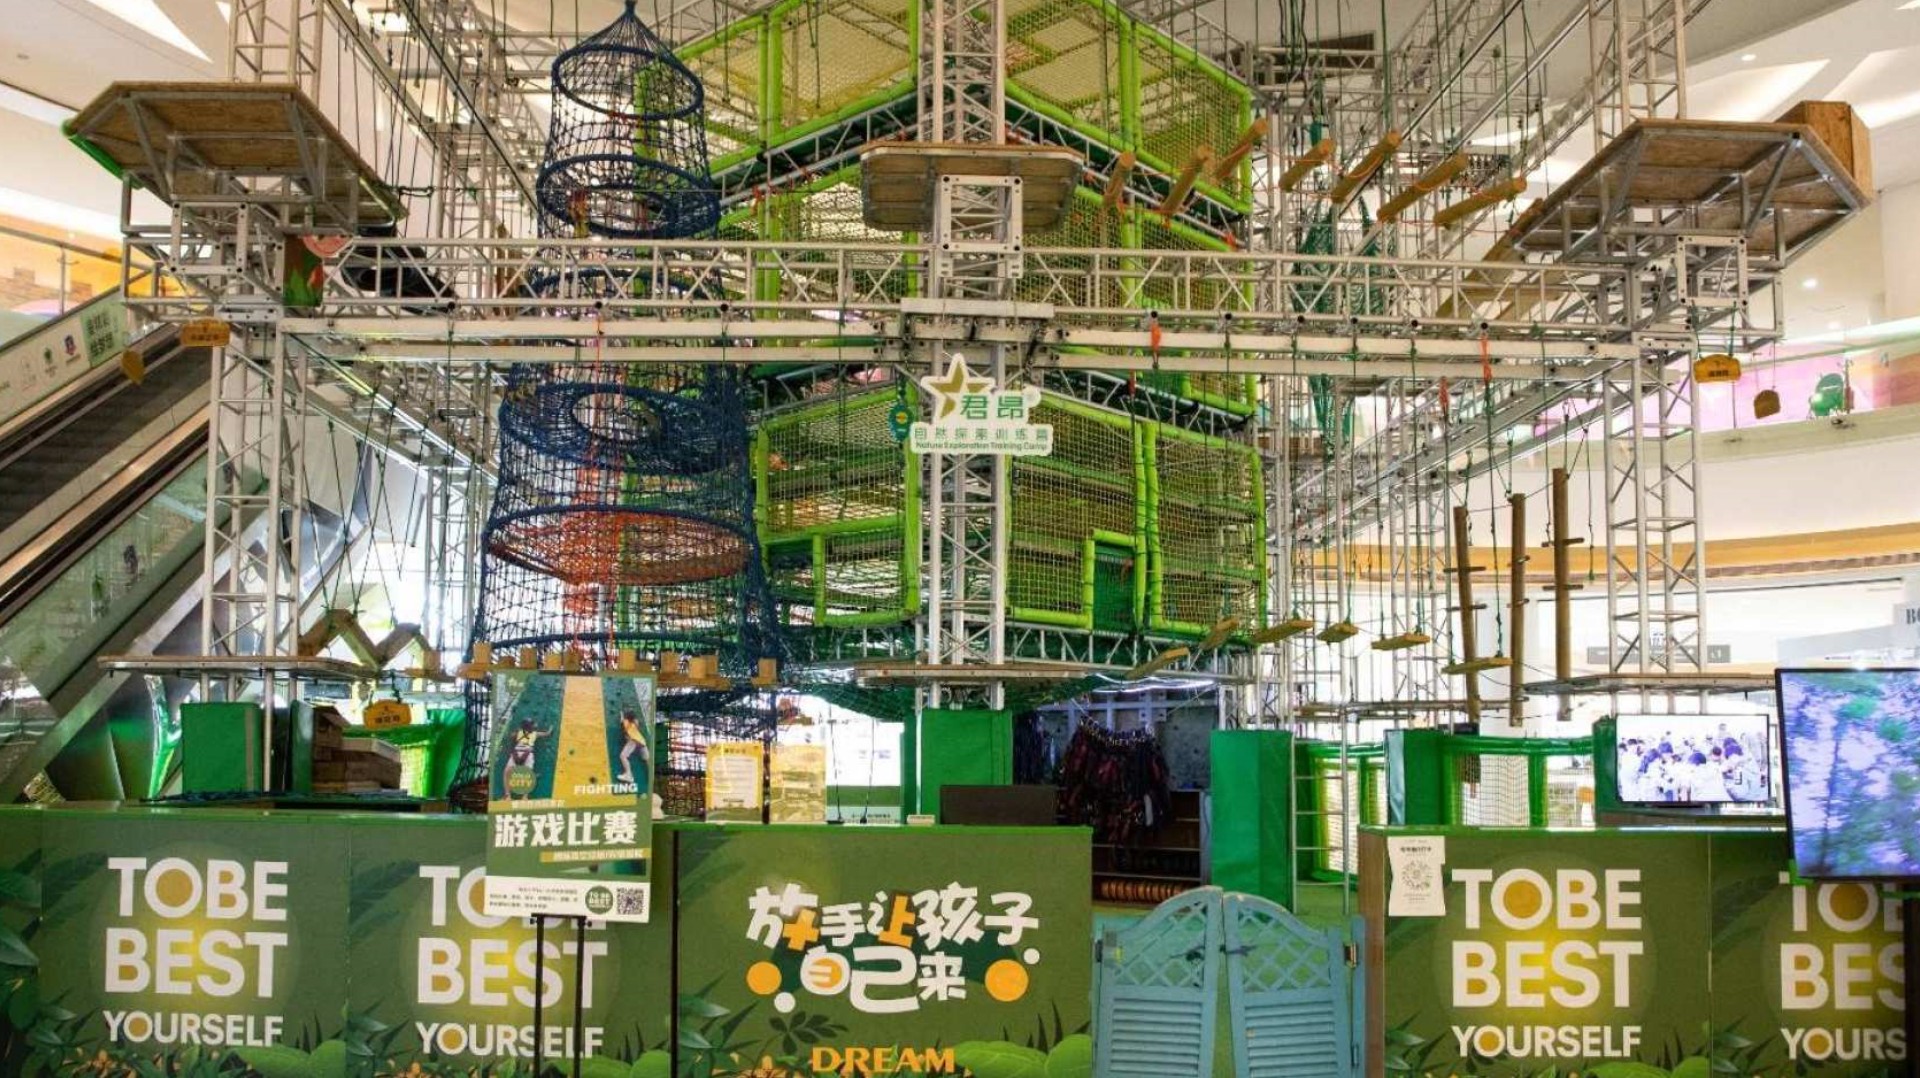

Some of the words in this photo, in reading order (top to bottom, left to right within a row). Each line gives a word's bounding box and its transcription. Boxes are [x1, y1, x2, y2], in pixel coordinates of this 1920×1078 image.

[960, 394, 1024, 420] 君昂
[574, 783, 638, 795] FIGHTING
[494, 810, 638, 848] 游戏比赛
[108, 857, 288, 921] TOBE
[1451, 868, 1642, 931] TOBE
[746, 880, 1039, 951] 放手让孩子
[105, 927, 288, 998] BEST
[418, 937, 608, 1009] BEST
[800, 945, 967, 1013] 自己来
[1452, 940, 1644, 1008] BEST
[103, 1009, 283, 1047] YOURSELF
[415, 1022, 604, 1059] YOURSELF
[1451, 1024, 1642, 1058] YOURSELF
[812, 1047, 955, 1073] DREAM
